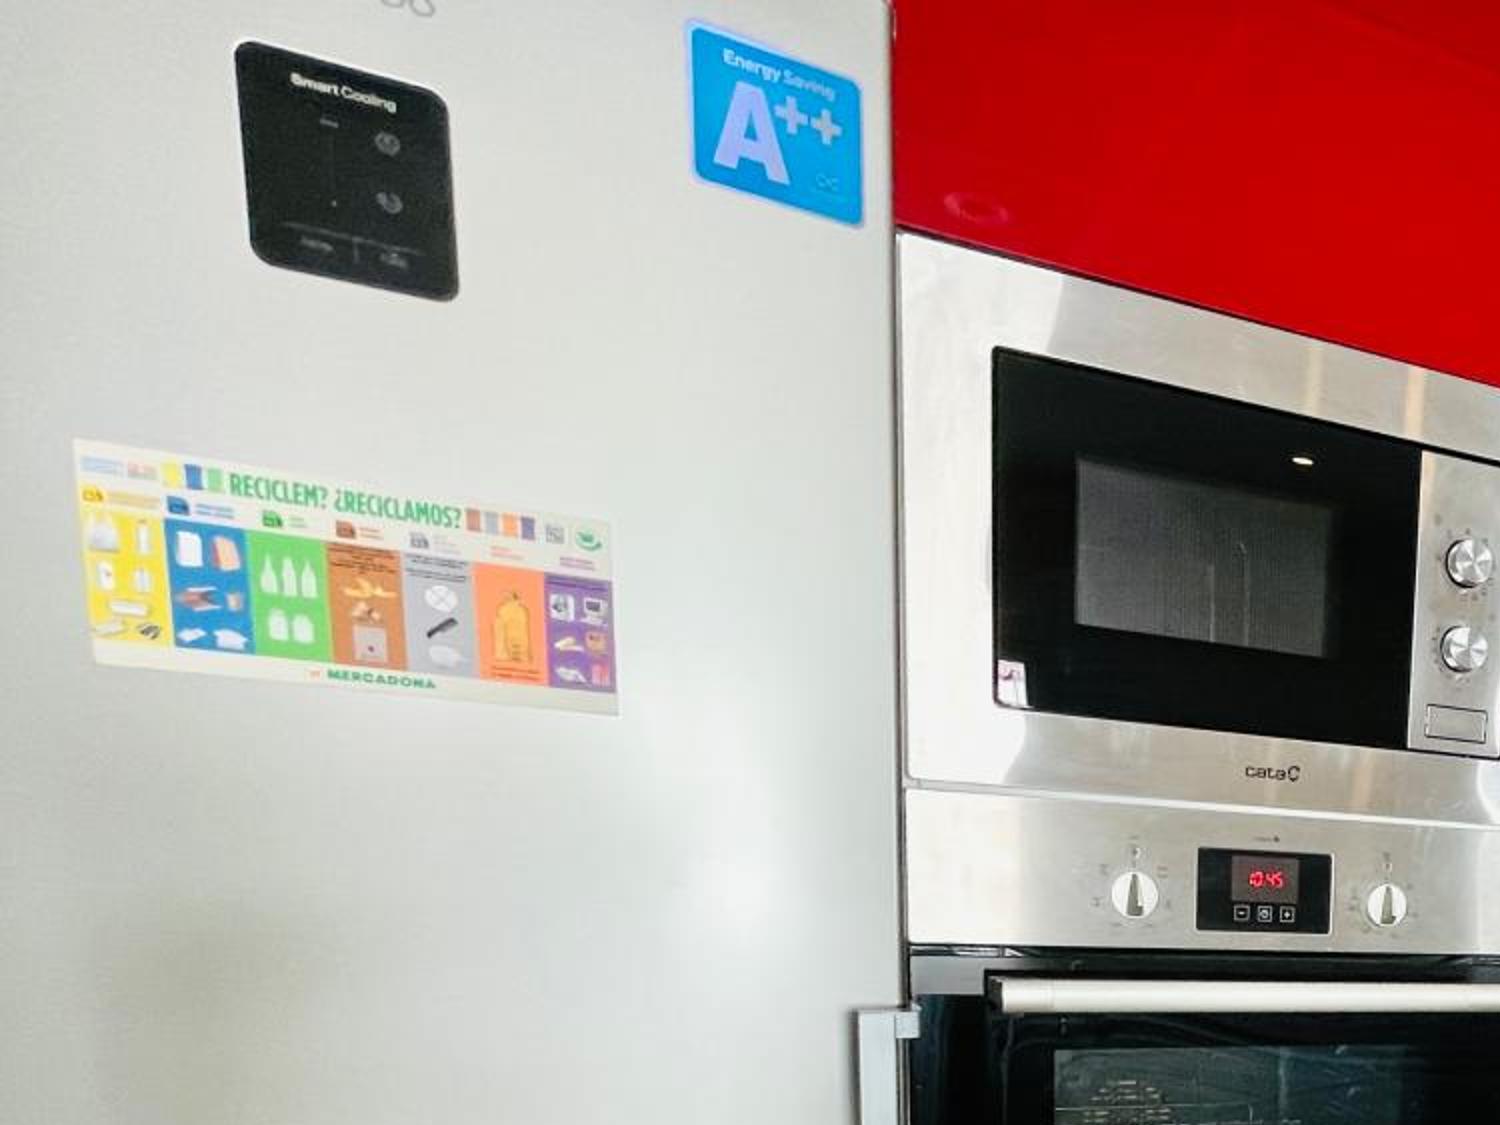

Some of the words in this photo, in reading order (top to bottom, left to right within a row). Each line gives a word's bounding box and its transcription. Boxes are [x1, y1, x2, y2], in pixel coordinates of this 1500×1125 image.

[290, 72, 339, 97] Smart
[340, 85, 397, 114] Cooling
[723, 48, 781, 83] Energy
[783, 69, 835, 102] Saving
[713, 80, 843, 186] A++
[229, 472, 328, 509] RECICLEM?
[334, 488, 461, 529] ¿RECICLAMOS?
[327, 669, 436, 689] MERCADONA
